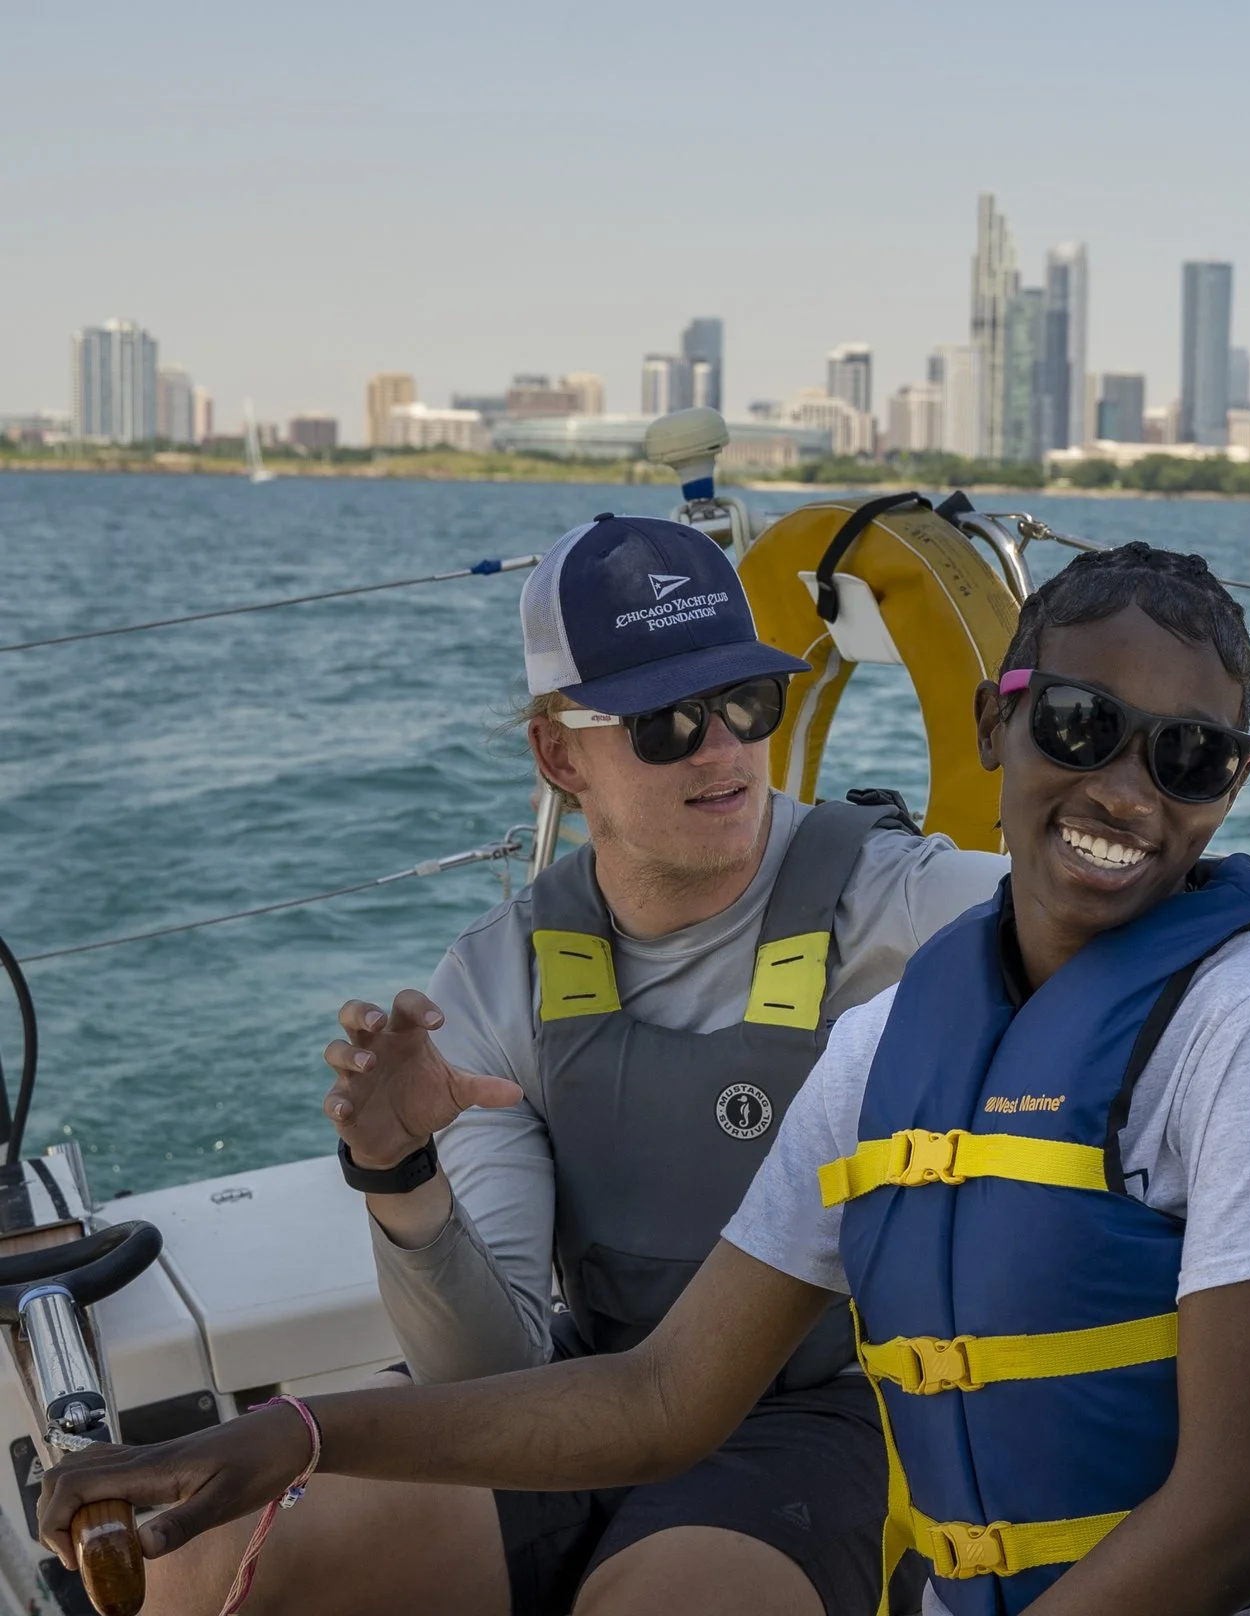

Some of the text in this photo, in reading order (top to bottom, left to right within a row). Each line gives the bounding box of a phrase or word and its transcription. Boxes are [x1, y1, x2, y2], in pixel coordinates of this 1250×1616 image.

[615, 591, 729, 629] CHICAGO YACHT CLUB
[646, 606, 717, 631] FOUNDATION
[719, 1085, 769, 1108] MUSTANG
[994, 1096, 1019, 1113] West
[719, 1114, 770, 1137] SURVIVAL
